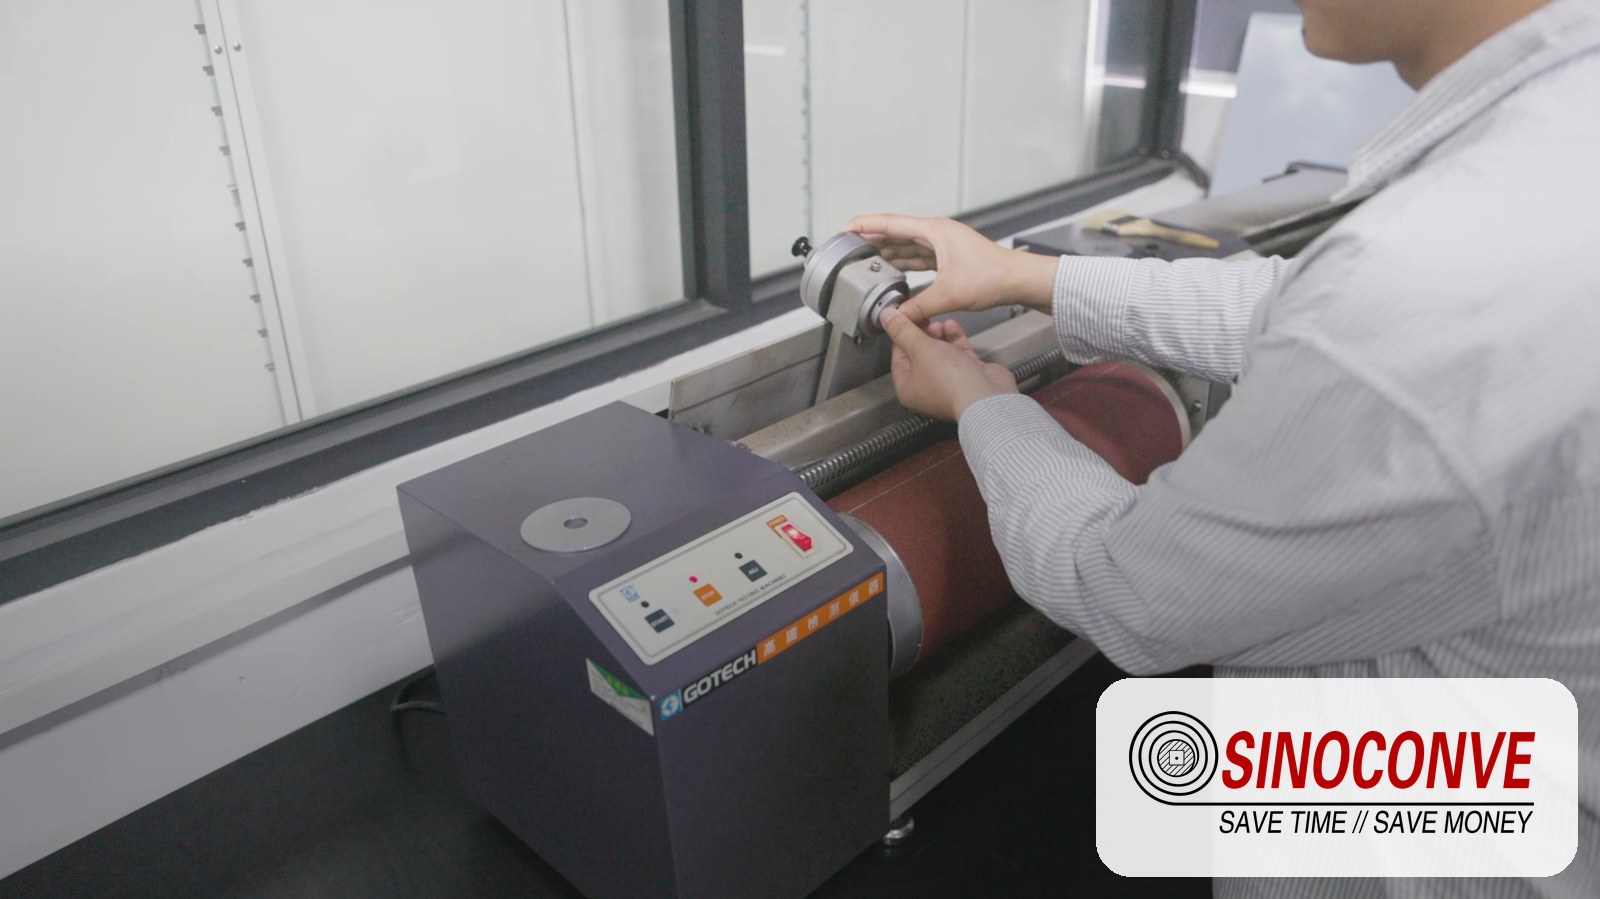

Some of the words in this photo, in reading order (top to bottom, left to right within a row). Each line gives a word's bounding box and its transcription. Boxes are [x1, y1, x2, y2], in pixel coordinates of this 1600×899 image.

[701, 590, 715, 601] STOP
[650, 614, 669, 628] START
[683, 649, 757, 704] GOTECH
